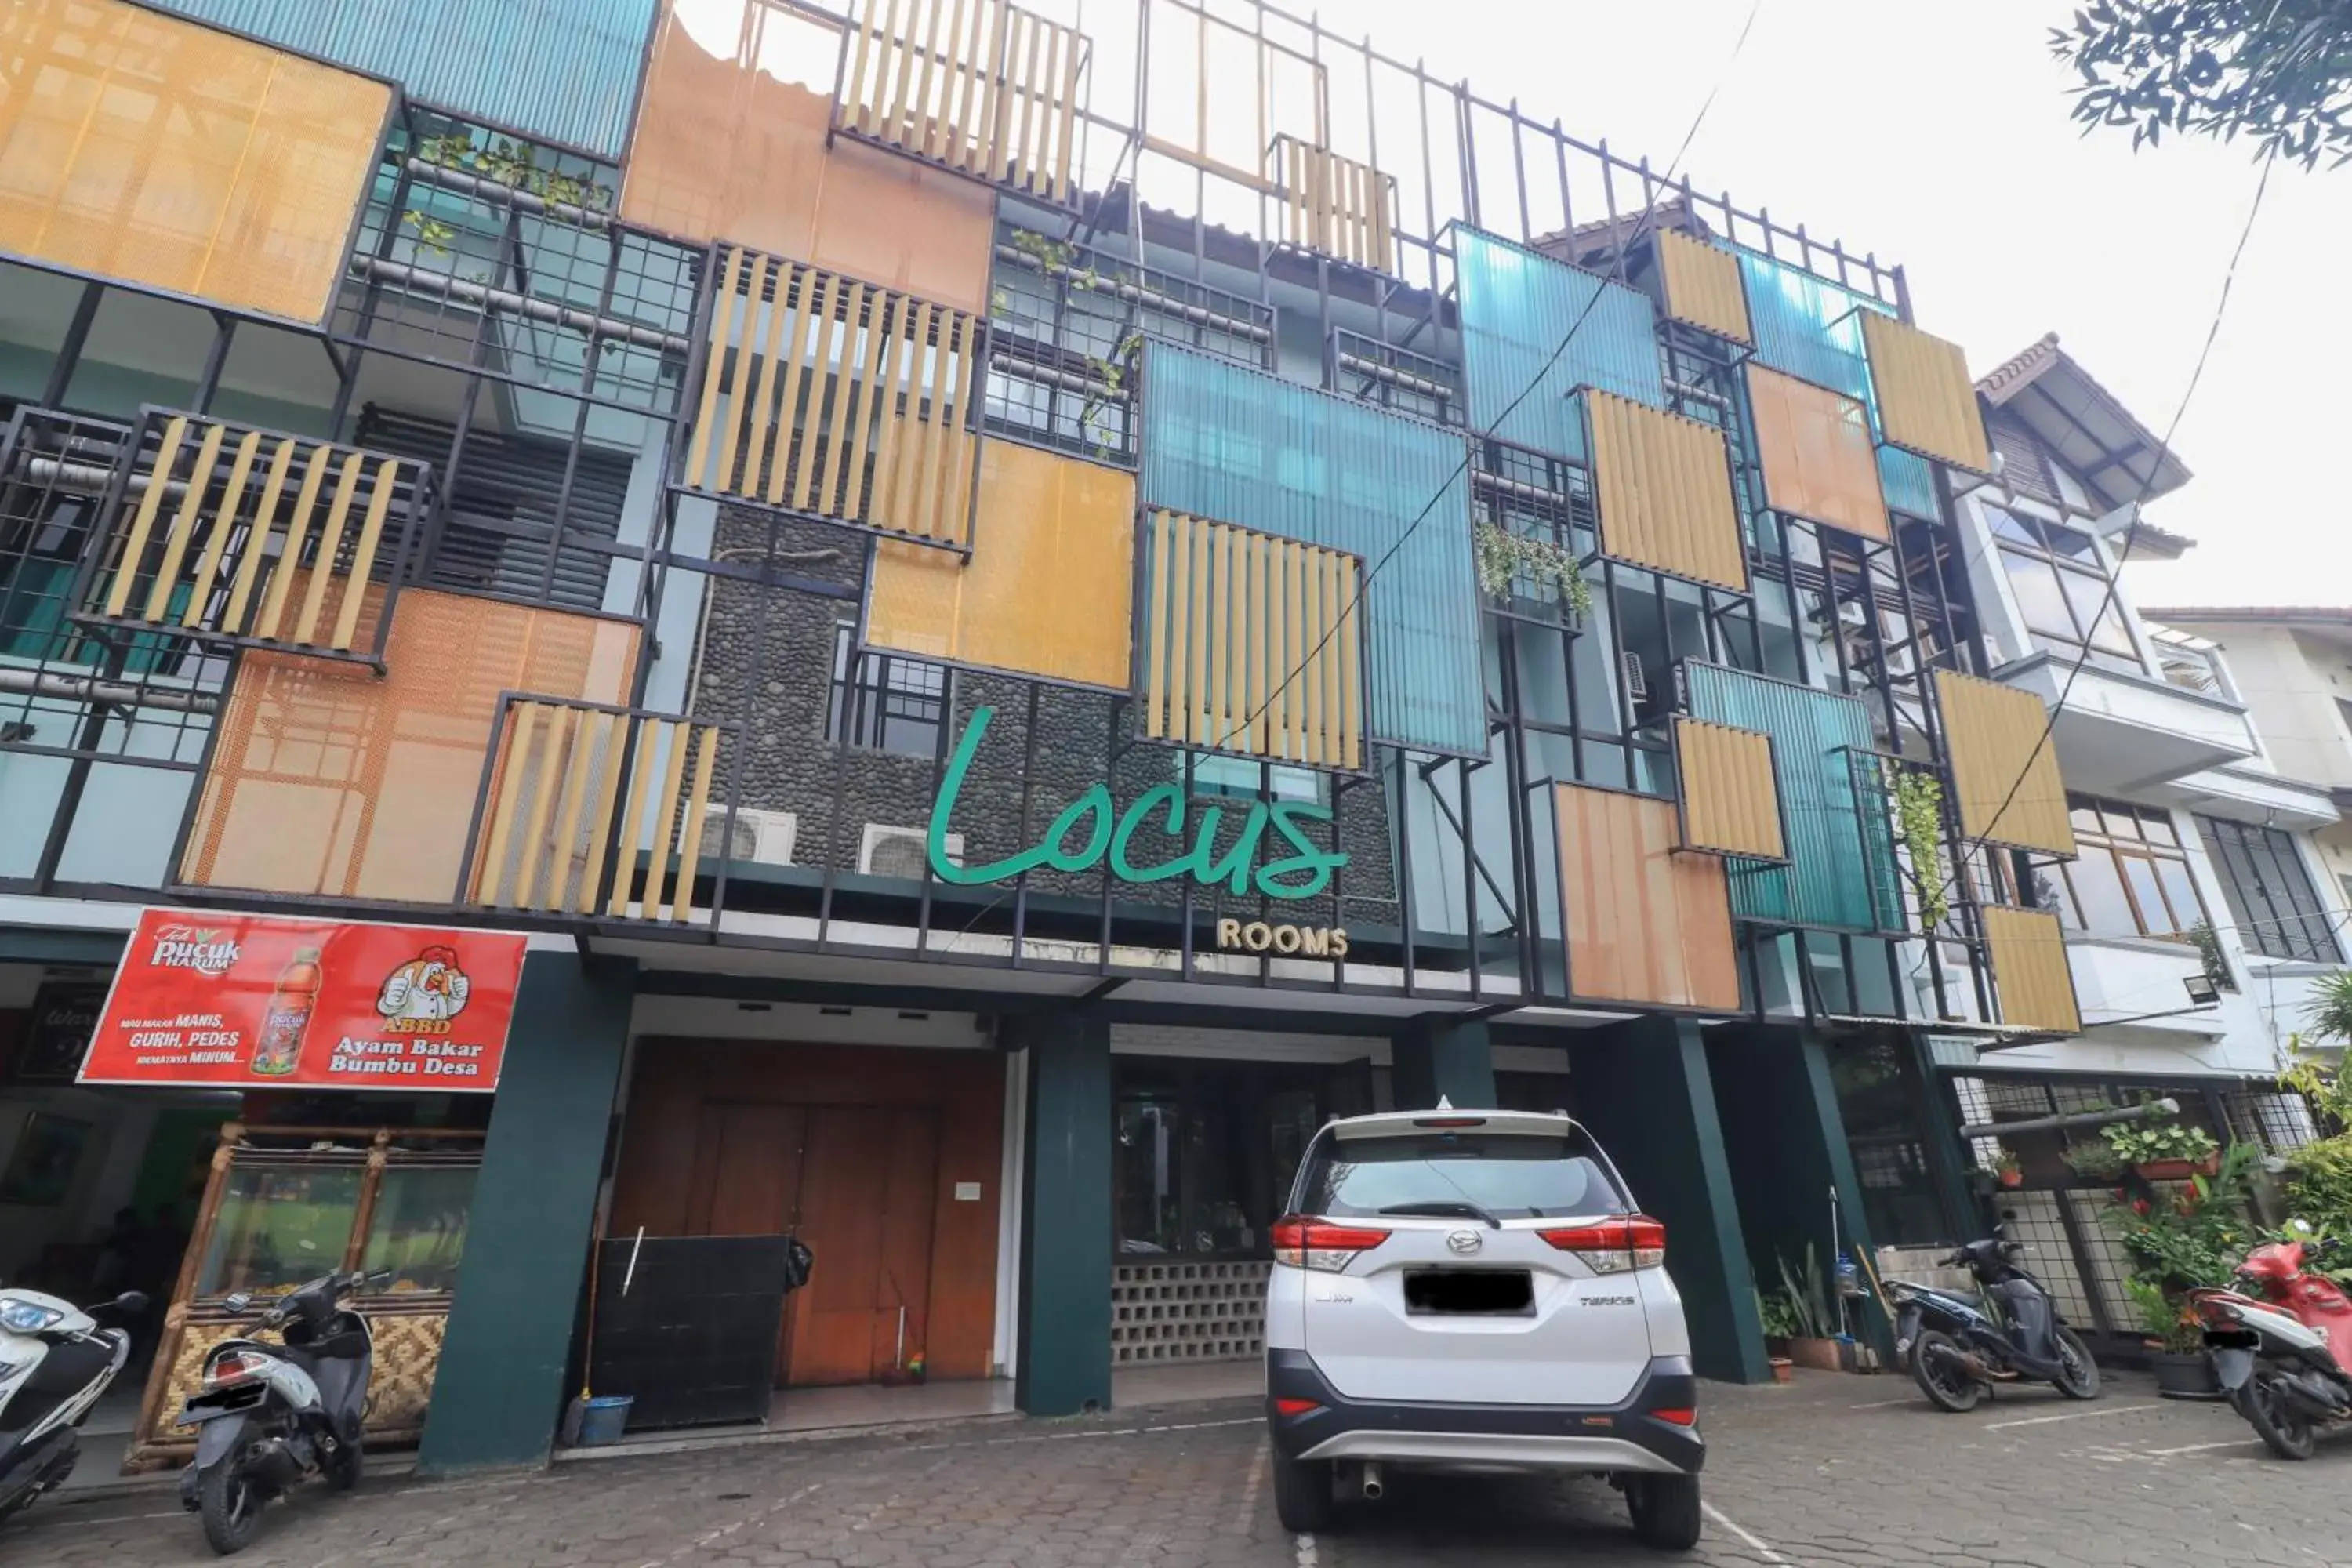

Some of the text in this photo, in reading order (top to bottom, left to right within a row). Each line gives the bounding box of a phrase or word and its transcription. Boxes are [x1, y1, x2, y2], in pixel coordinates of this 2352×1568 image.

[928, 707, 1352, 900] Locus
[1217, 918, 1348, 957] ROOMS
[165, 956, 230, 970] HARUM
[175, 1014, 223, 1029] MANIS,
[380, 1018, 452, 1034] ABBD
[188, 1031, 240, 1047] PEDES
[334, 1036, 484, 1057] Ayam Bakar
[329, 1054, 478, 1075] Bumbu Desa
